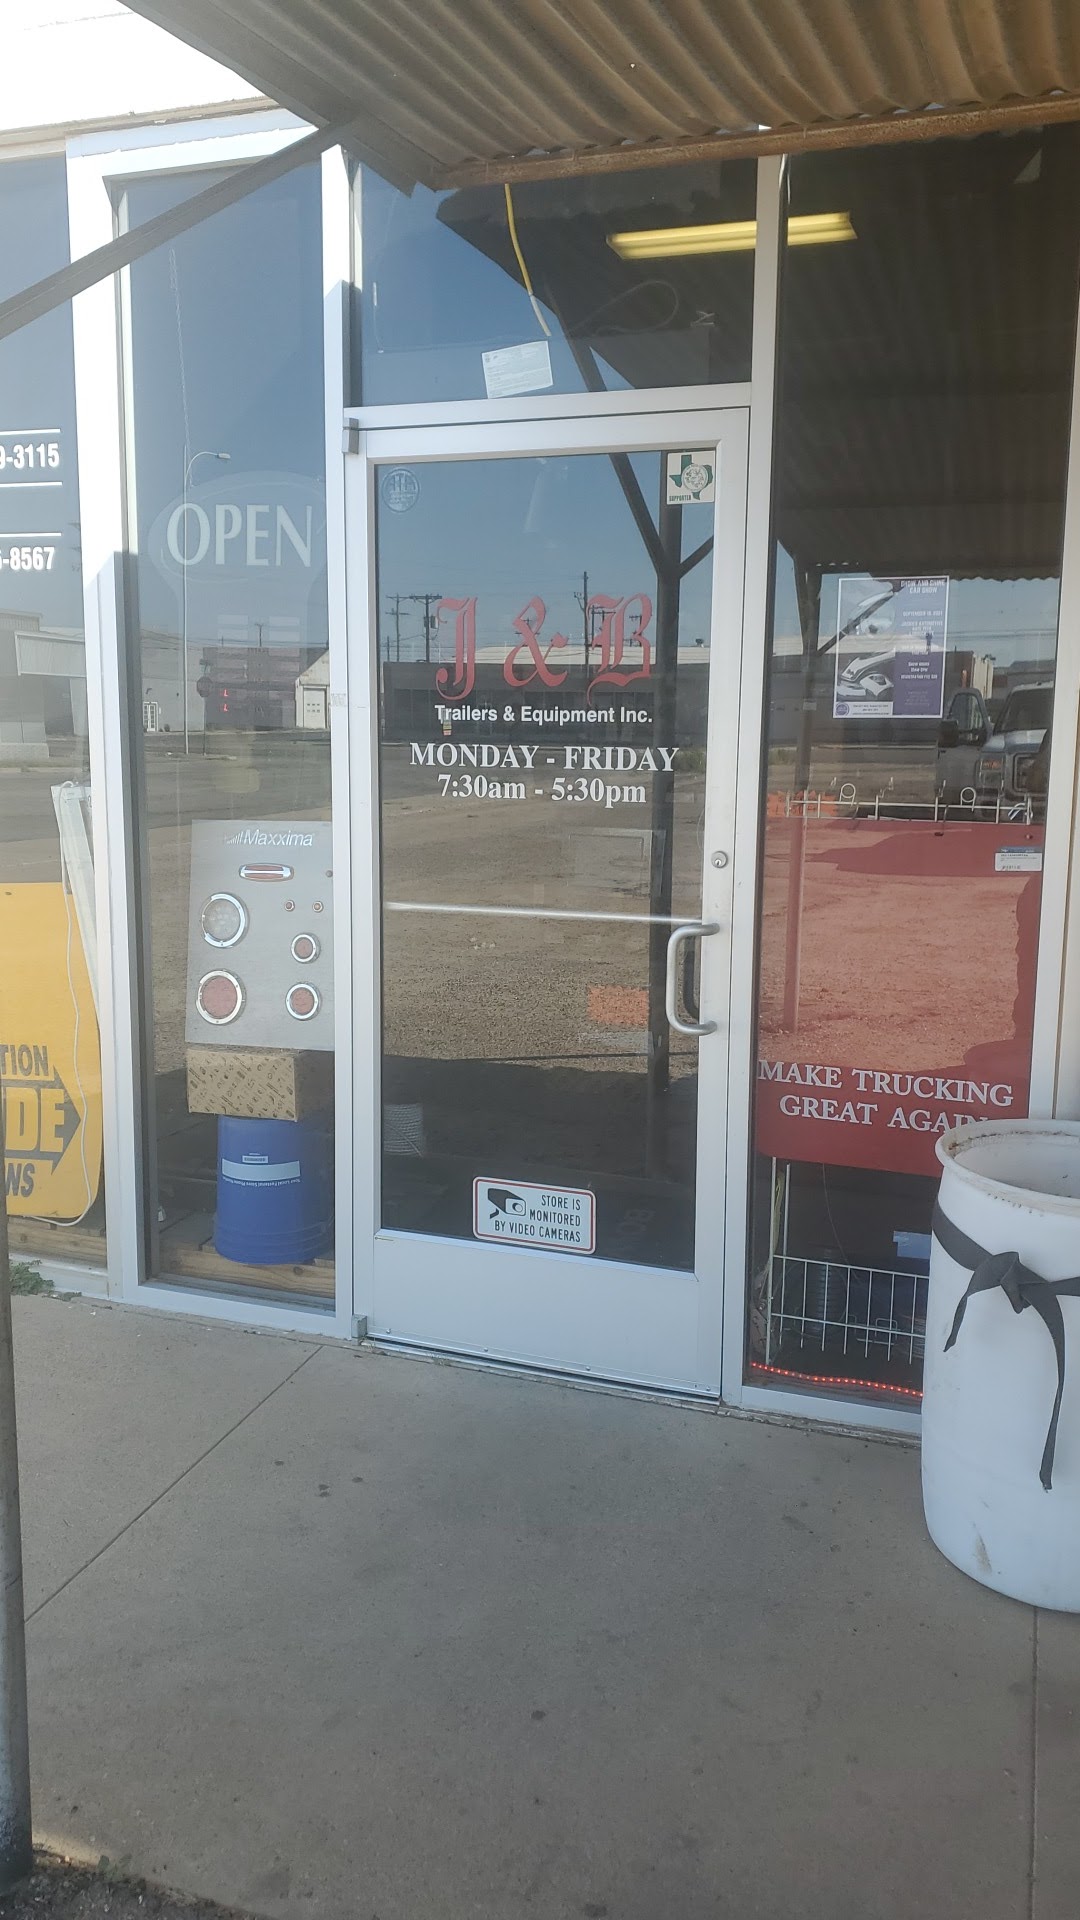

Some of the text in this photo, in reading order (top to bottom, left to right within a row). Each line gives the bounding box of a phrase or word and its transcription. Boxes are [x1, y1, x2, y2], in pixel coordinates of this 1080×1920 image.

[167, 503, 313, 568] OPEN
[0, 546, 55, 571] -8567
[436, 593, 653, 706] J & B
[435, 704, 653, 726] Trailers & Equipment Inc.
[410, 742, 539, 769] MONDAY
[563, 746, 680, 772] FRIDAY
[437, 774, 526, 799] 7:30am
[551, 777, 647, 808] 5:30pm
[243, 829, 313, 846] Maxxima
[757, 1060, 1014, 1107] MAKE TRUCKING
[779, 1095, 878, 1125] GREAT
[541, 1194, 581, 1211] STORE IS
[529, 1208, 581, 1227] MONITORED
[494, 1220, 581, 1243] BY VIDEO CAMERAS
